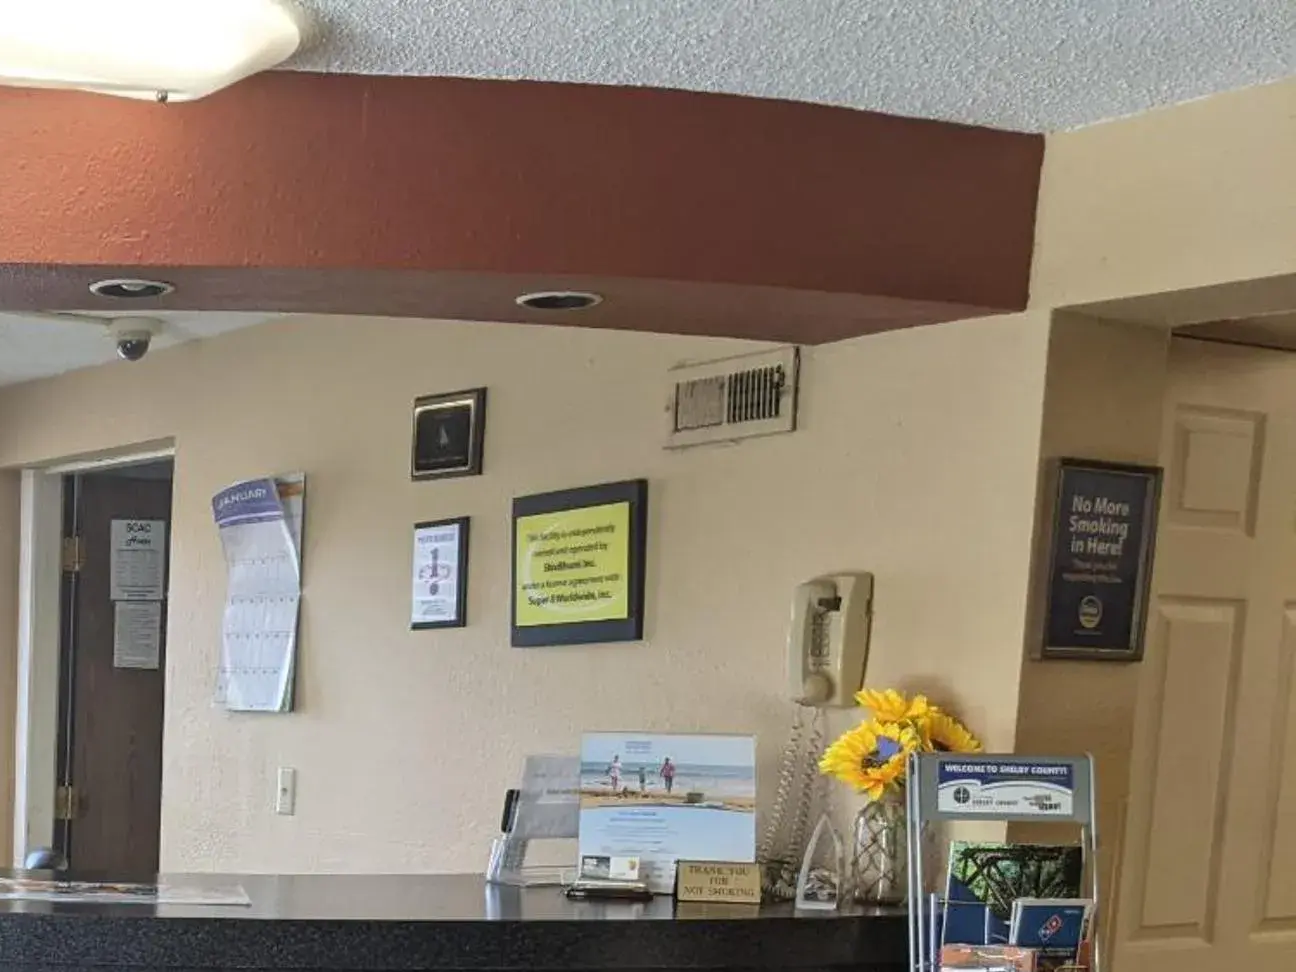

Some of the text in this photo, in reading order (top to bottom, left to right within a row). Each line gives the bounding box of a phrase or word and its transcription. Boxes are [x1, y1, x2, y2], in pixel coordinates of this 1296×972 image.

[1071, 494, 1130, 517] No More
[1068, 515, 1129, 539] Smoking
[1070, 534, 1124, 556] in Here!
[944, 763, 985, 774] WELCOME
[986, 764, 998, 774] TO
[999, 764, 1029, 775] SHELBY
